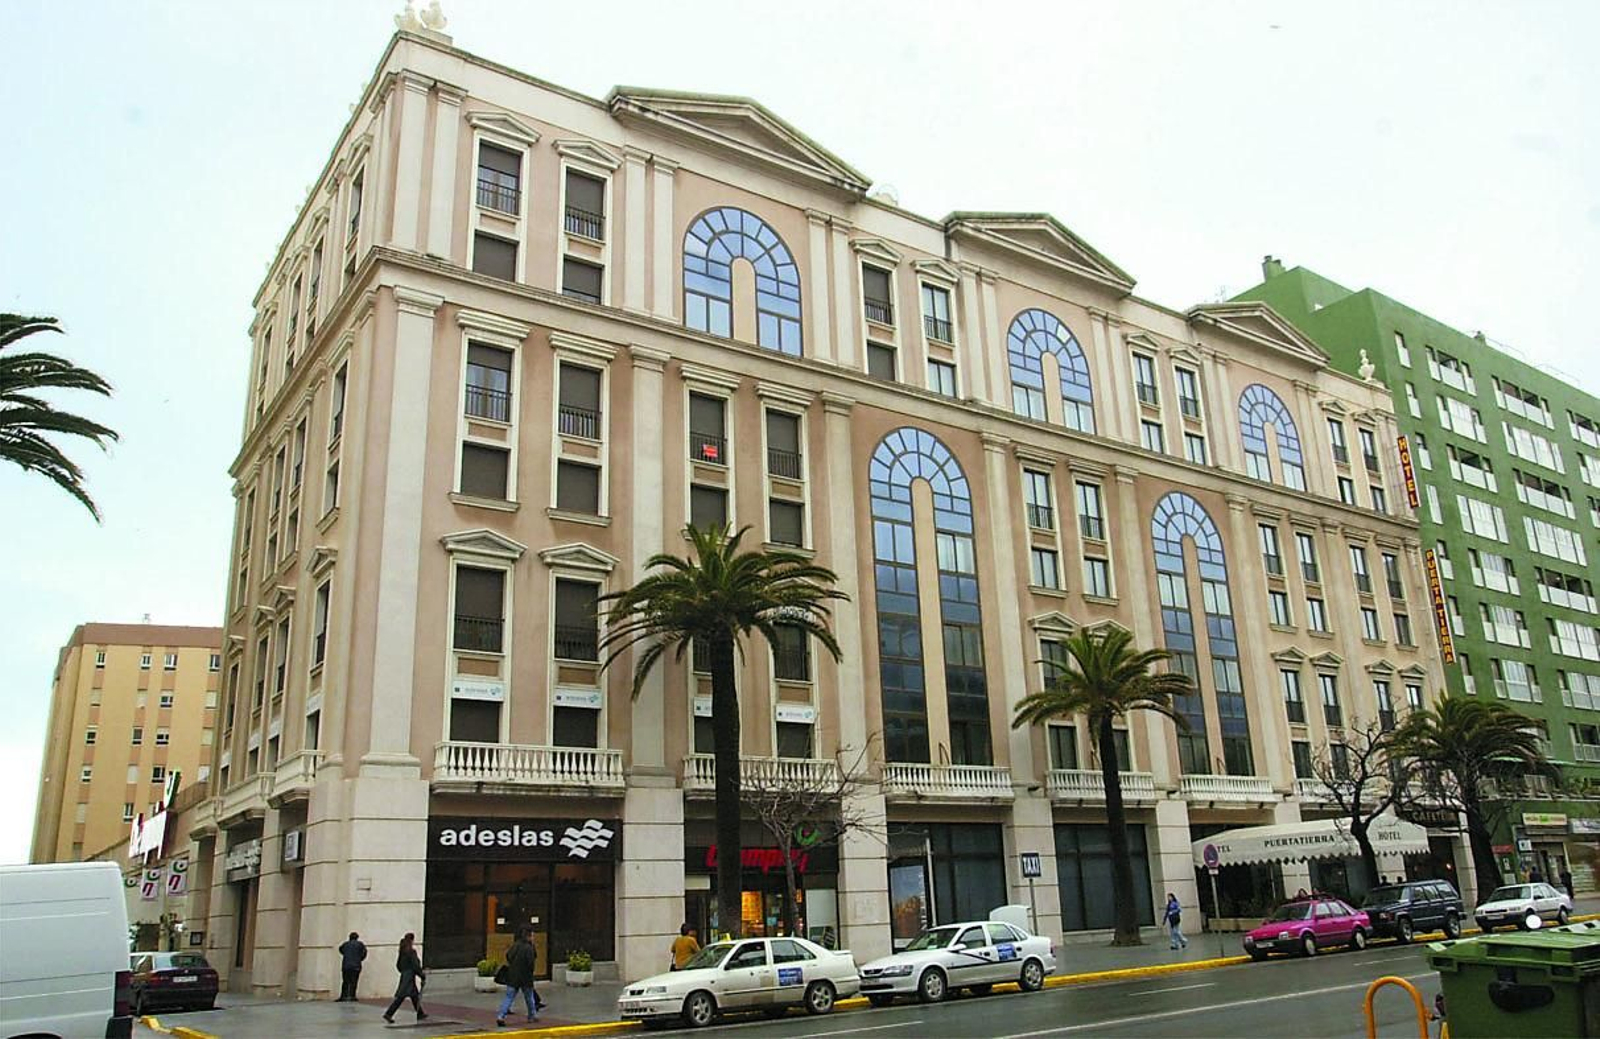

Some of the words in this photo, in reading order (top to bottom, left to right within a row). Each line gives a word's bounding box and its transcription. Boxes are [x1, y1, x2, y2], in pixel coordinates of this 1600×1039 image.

[1398, 437, 1418, 507] HOTEL
[1426, 551, 1442, 603] PUERTA
[1436, 609, 1453, 664] TIERRA
[439, 824, 554, 846] adeslas
[1377, 831, 1402, 841] HOTEL
[1022, 856, 1040, 875] TAXI
